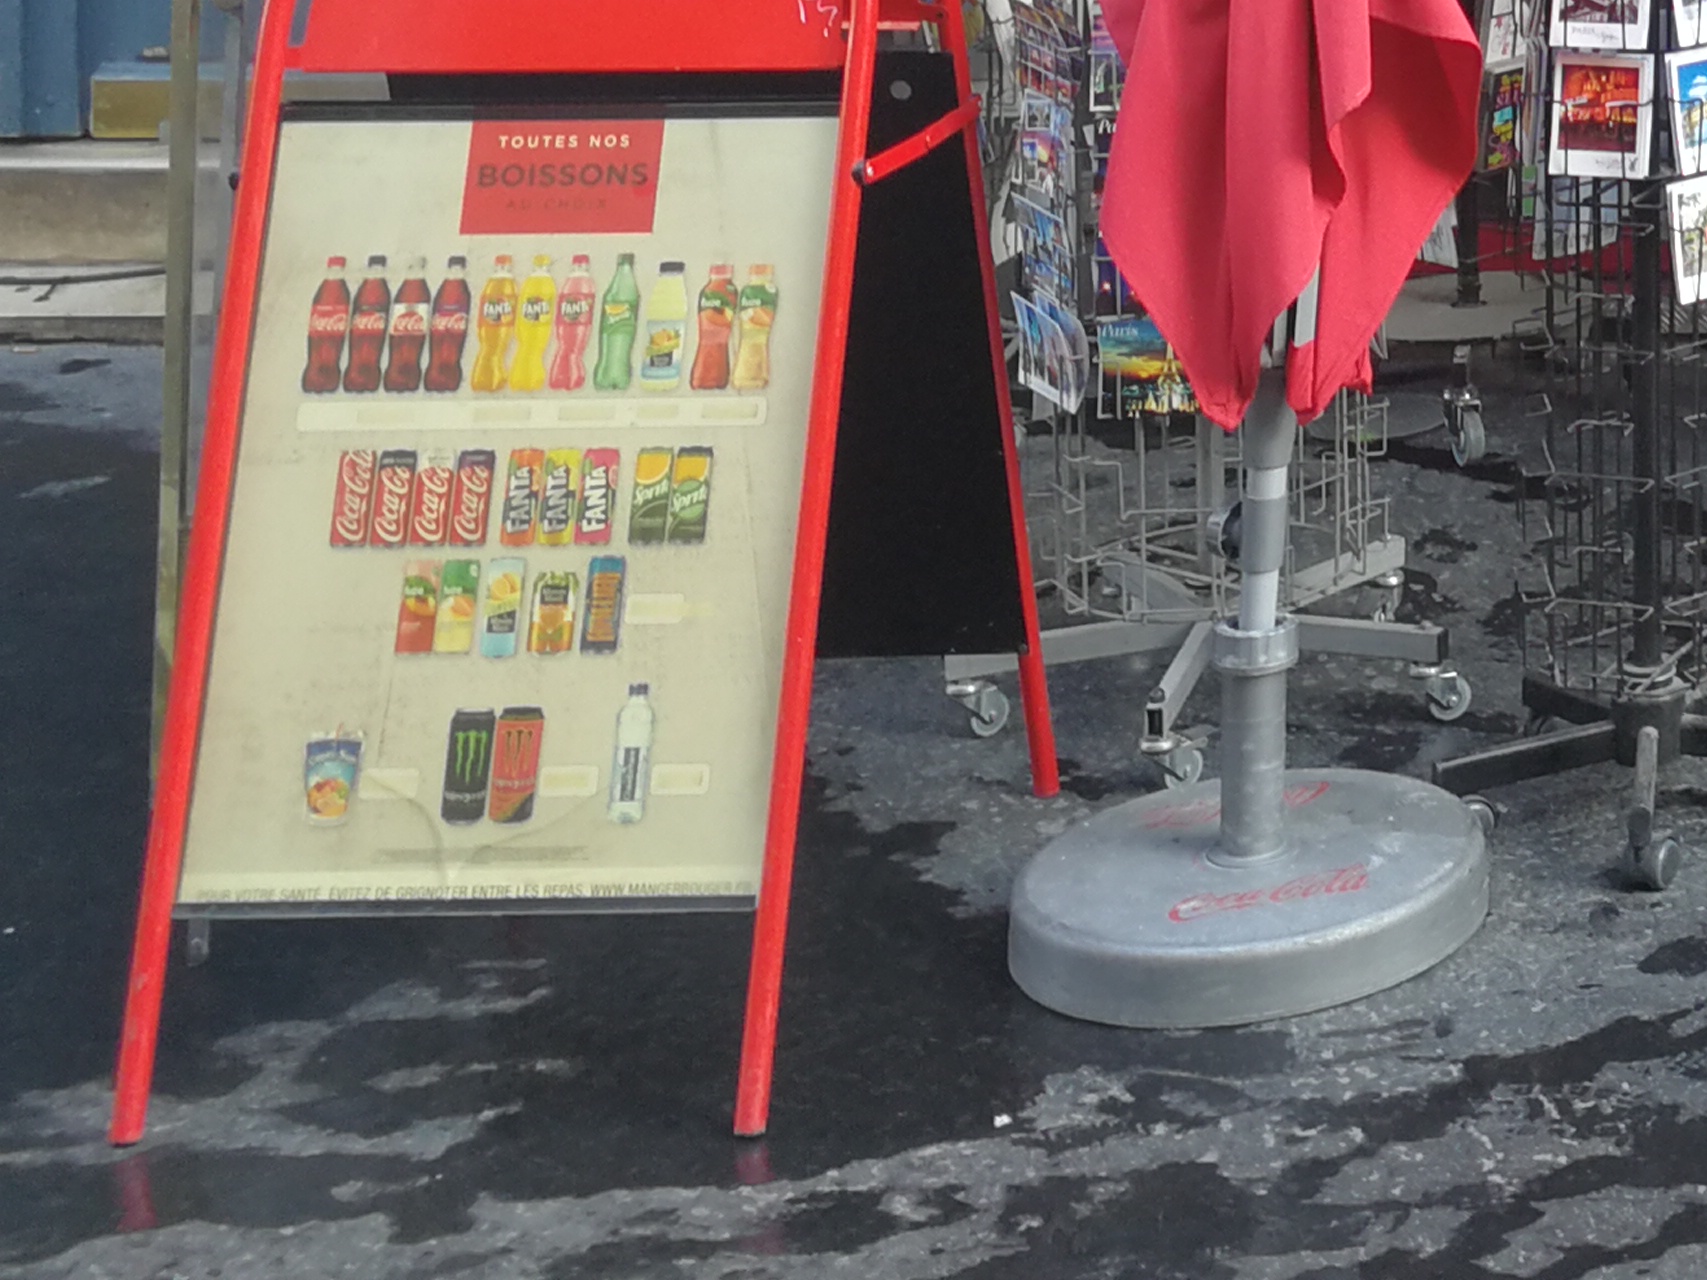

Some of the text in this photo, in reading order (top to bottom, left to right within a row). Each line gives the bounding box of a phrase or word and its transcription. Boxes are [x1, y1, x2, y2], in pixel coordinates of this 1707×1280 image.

[498, 134, 630, 149] TOUTES NOS
[476, 162, 649, 188] BOISSONS
[1100, 323, 1139, 337] Paris
[507, 465, 534, 534] FANTA
[581, 464, 607, 534] FANTA
